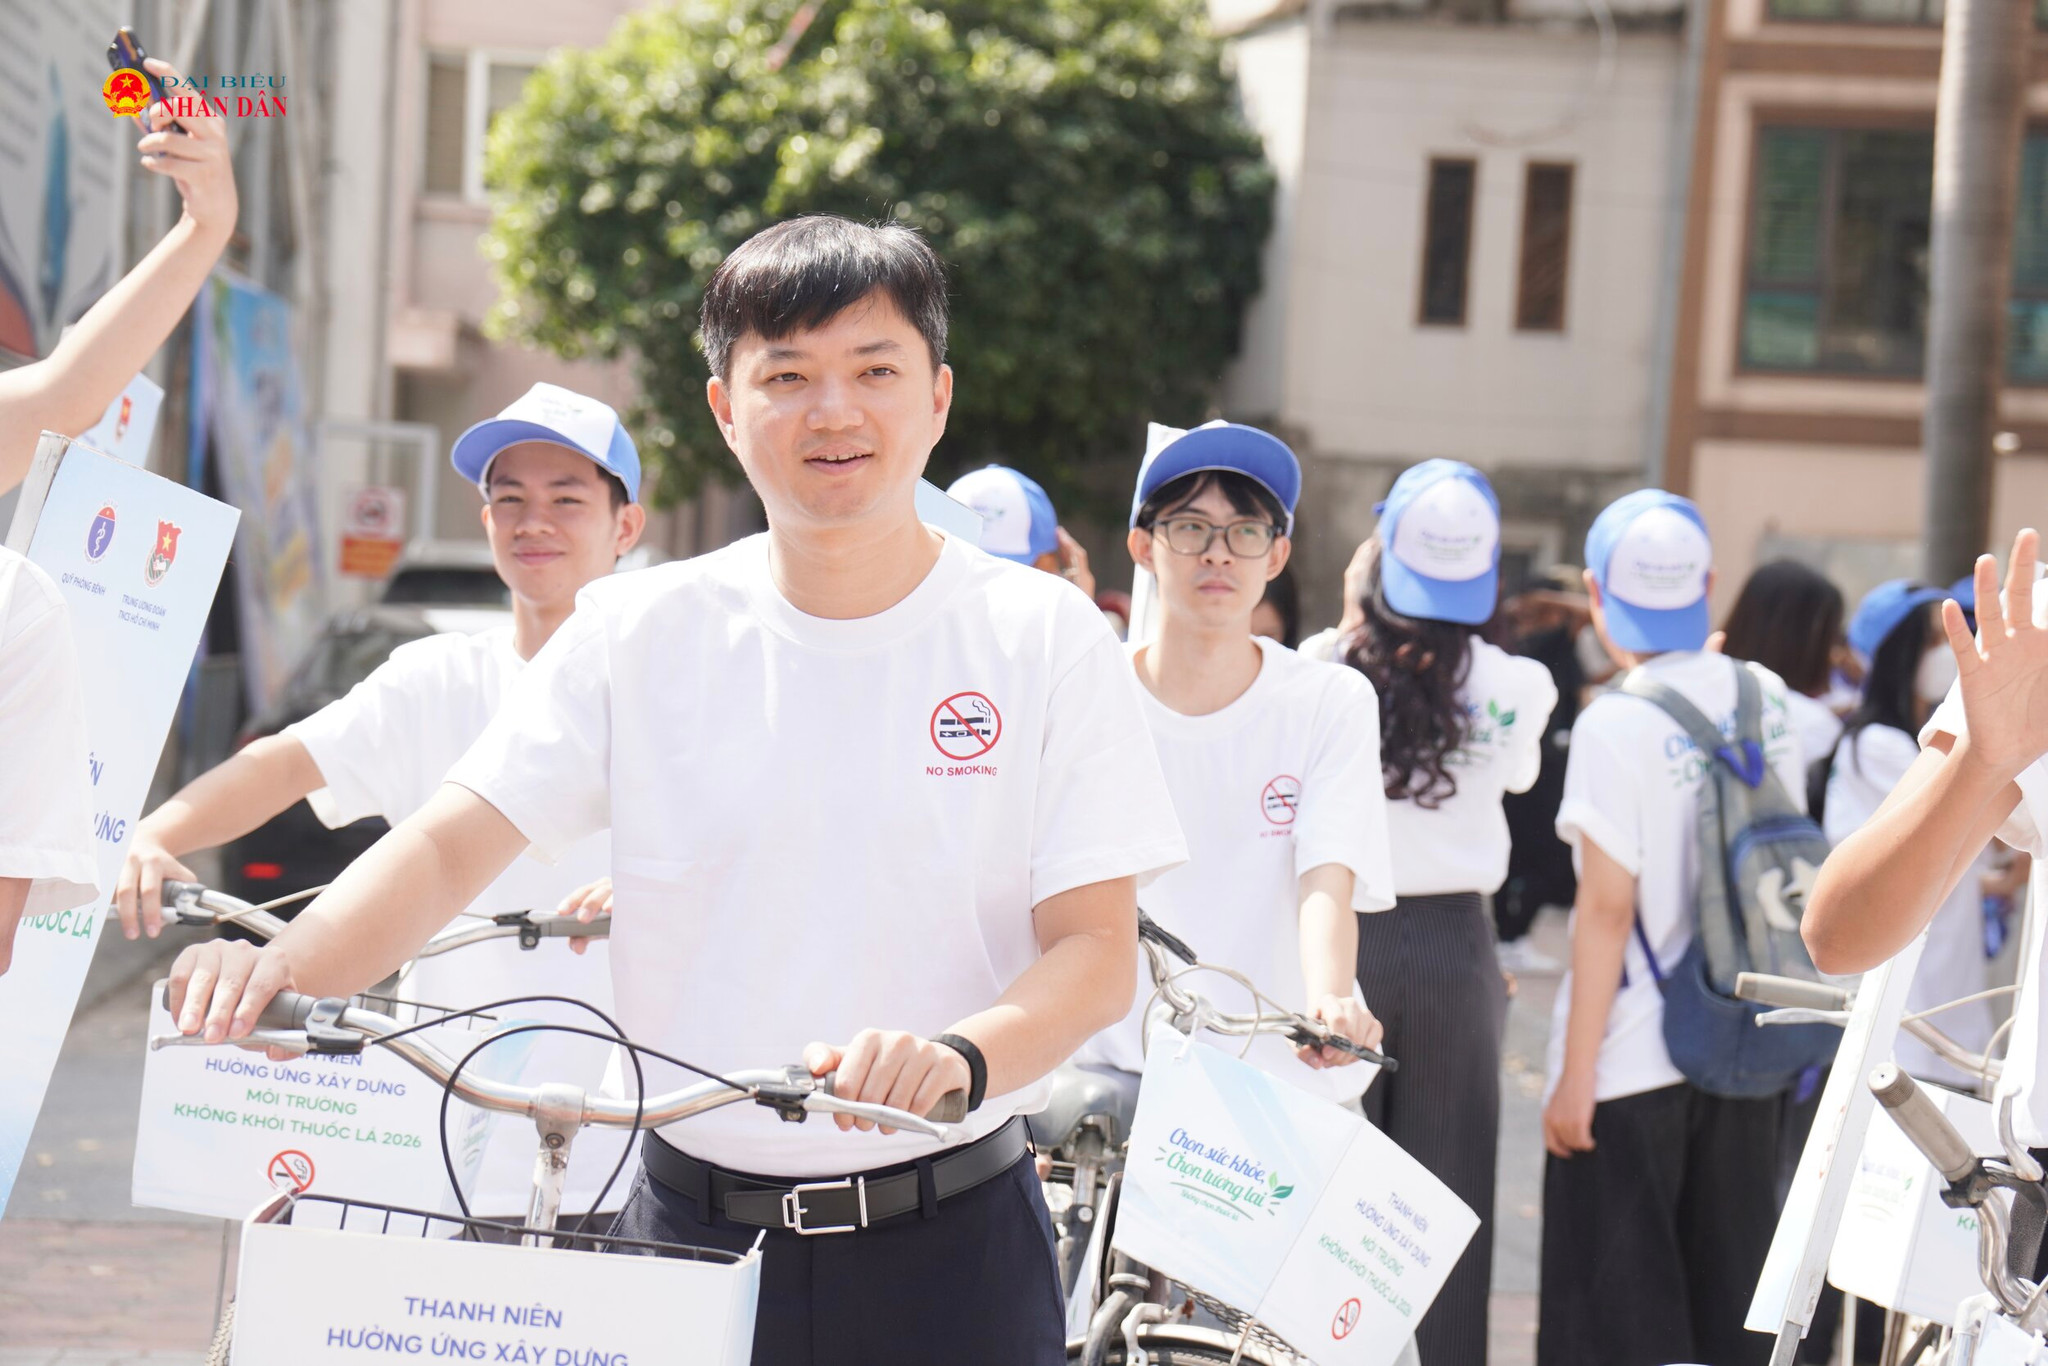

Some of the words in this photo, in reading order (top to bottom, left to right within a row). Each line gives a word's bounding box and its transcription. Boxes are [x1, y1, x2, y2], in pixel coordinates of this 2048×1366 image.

[926, 766, 943, 776] NO
[947, 765, 998, 776] SMOKING
[71, 907, 97, 939] LÁ
[273, 1063, 312, 1085] ỨNG
[316, 1072, 352, 1091] XÂY
[356, 1078, 406, 1097] DỰNG
[246, 1088, 280, 1106] MÔI
[285, 1093, 358, 1116] TRƯỜNG
[174, 1102, 237, 1124] KHÔNG
[241, 1112, 285, 1132] KHÓI
[290, 1117, 351, 1140] THUỐC
[355, 1125, 377, 1143] LÁ
[382, 1131, 422, 1149] 2026
[1169, 1127, 1205, 1156] Chọn
[1205, 1146, 1232, 1166] sức
[1167, 1151, 1204, 1179] Chọn
[1243, 1186, 1268, 1208] lai
[1388, 1191, 1413, 1218] THANH
[404, 1296, 495, 1323] THANH
[503, 1302, 563, 1329] NIÊN
[326, 1324, 423, 1354] HƯỞNG
[431, 1331, 487, 1360] ỨNG
[494, 1339, 547, 1365] XÂY
